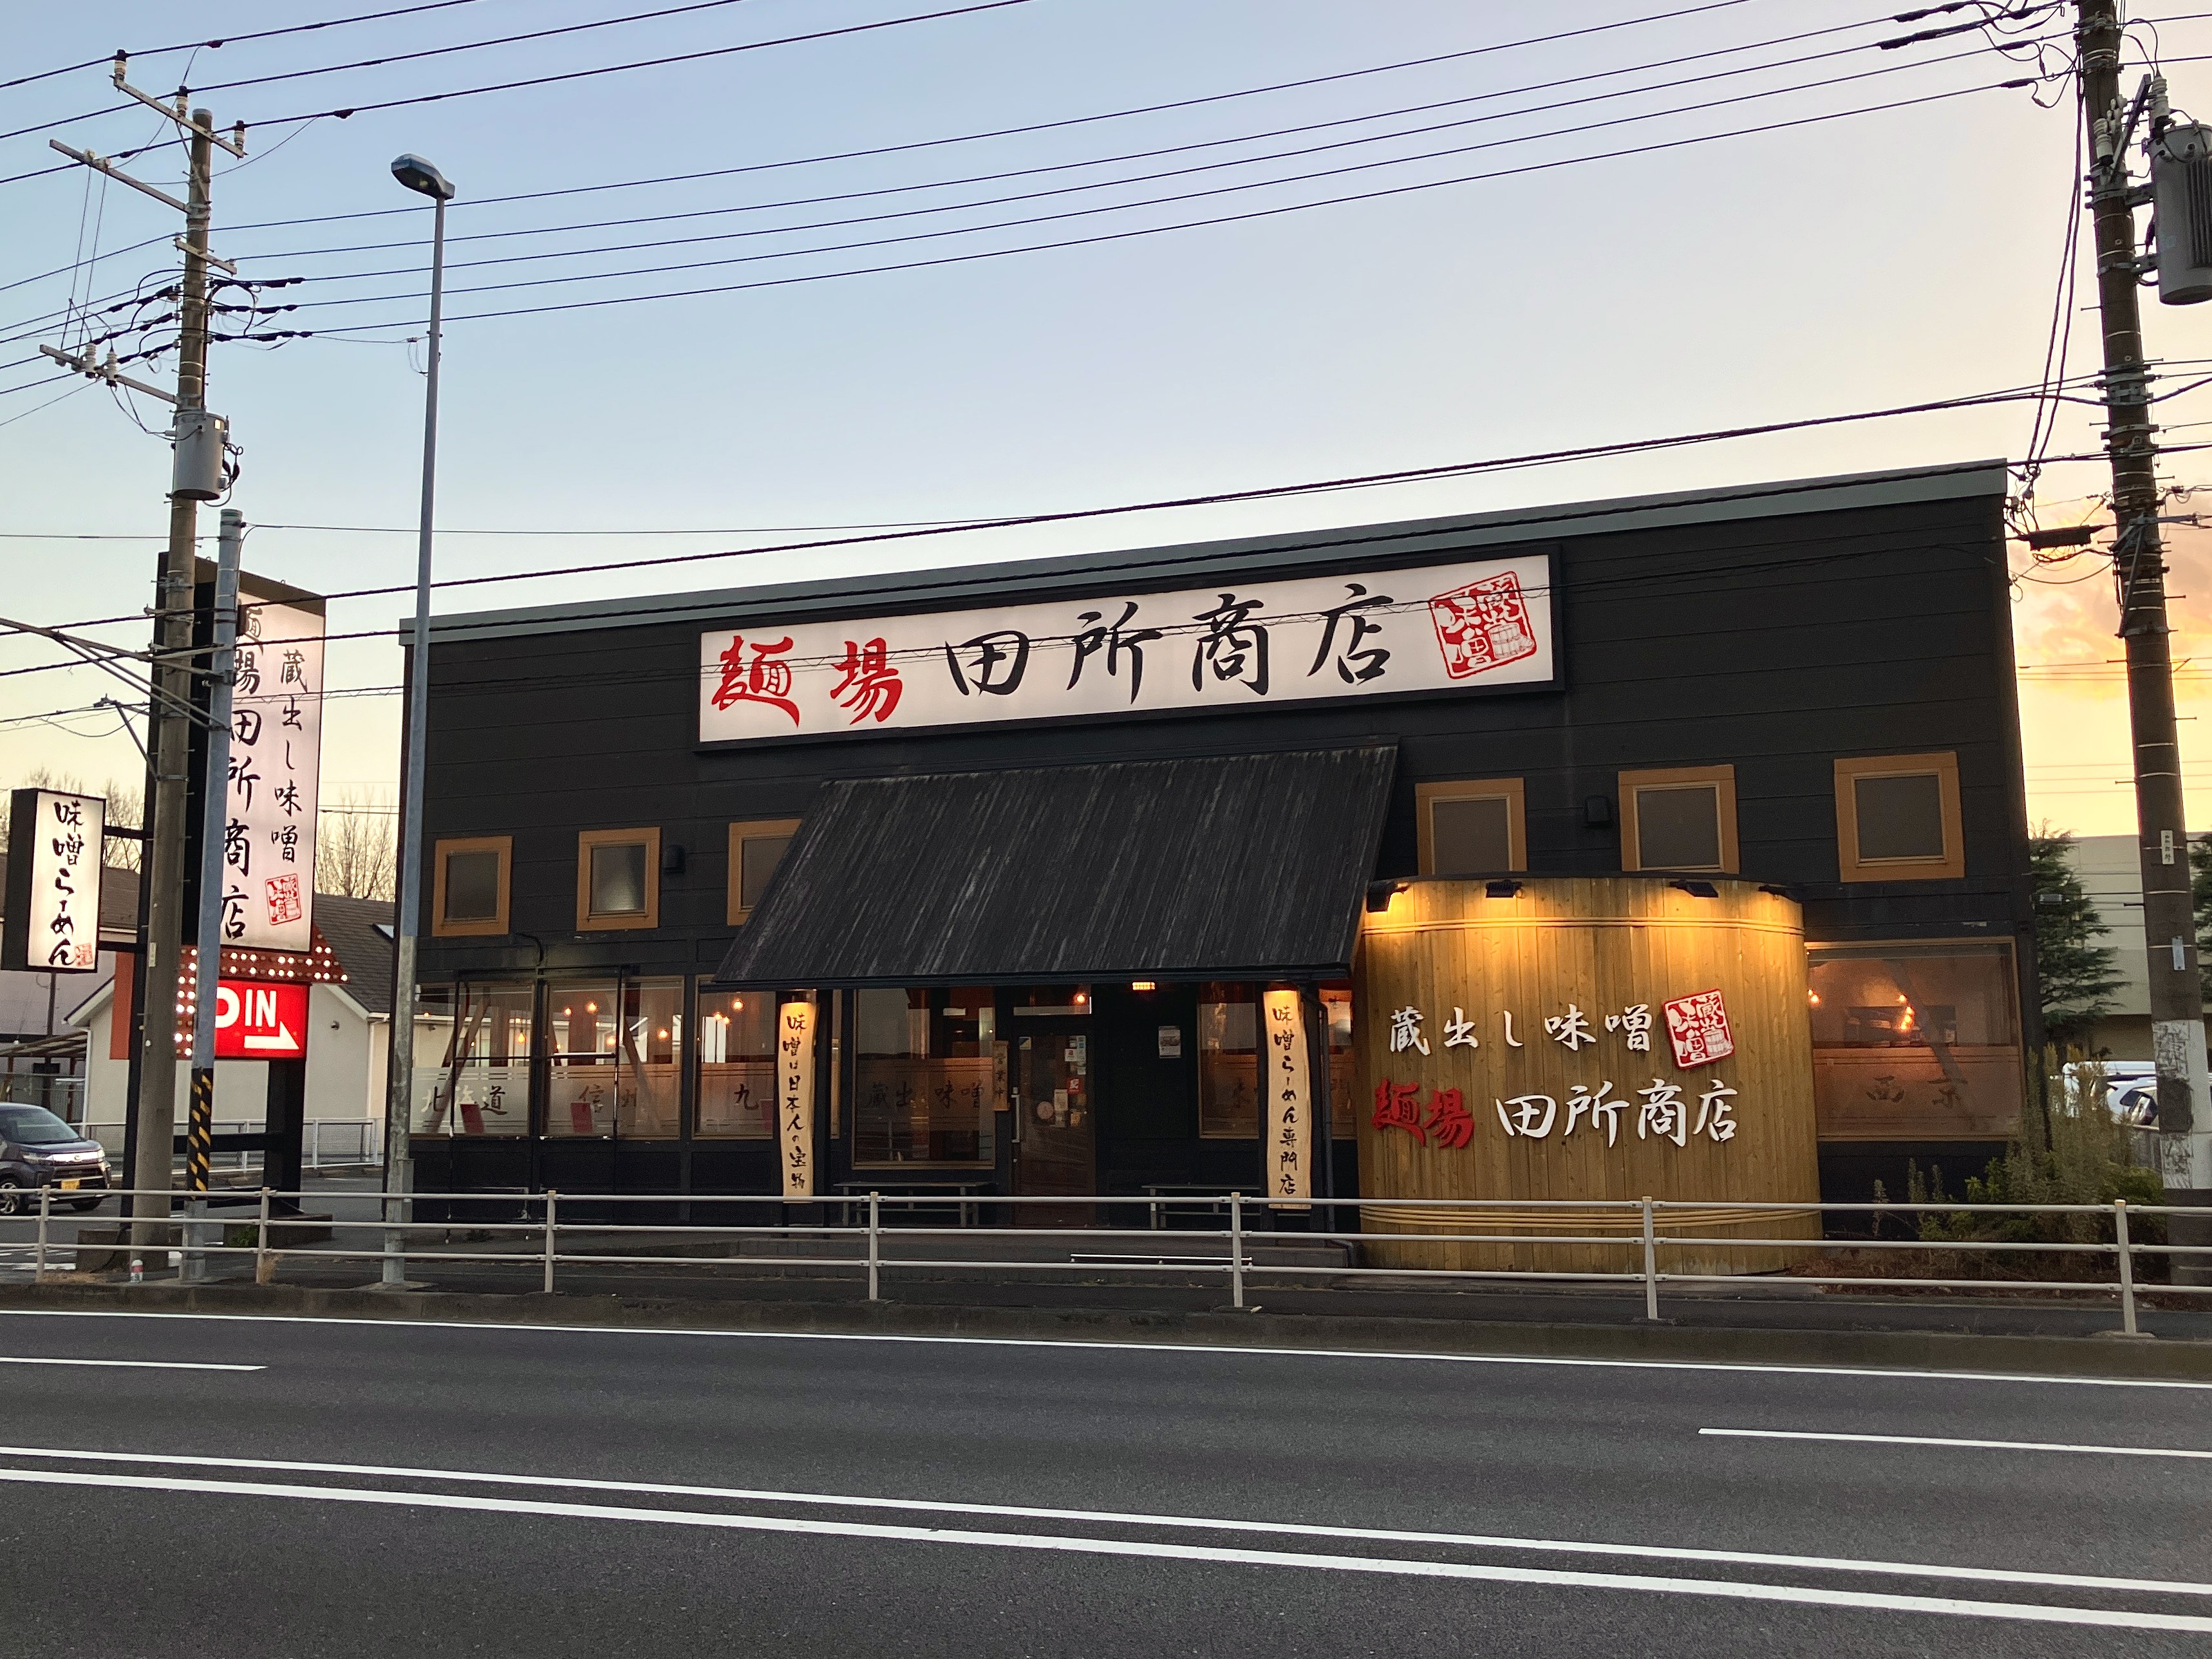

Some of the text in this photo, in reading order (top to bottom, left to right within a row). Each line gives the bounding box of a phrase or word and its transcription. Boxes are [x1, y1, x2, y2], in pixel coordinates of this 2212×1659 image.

[271, 650, 308, 863] 蔵出し味噌
[48, 800, 84, 966] 味噌らーめん
[245, 989, 277, 1027] IN
[1390, 1004, 1653, 1056] 蔵出し味噌
[783, 1013, 807, 1189] 味噌は日本人の宝物
[1272, 1005, 1300, 1194] 味噌らーめん専門店
